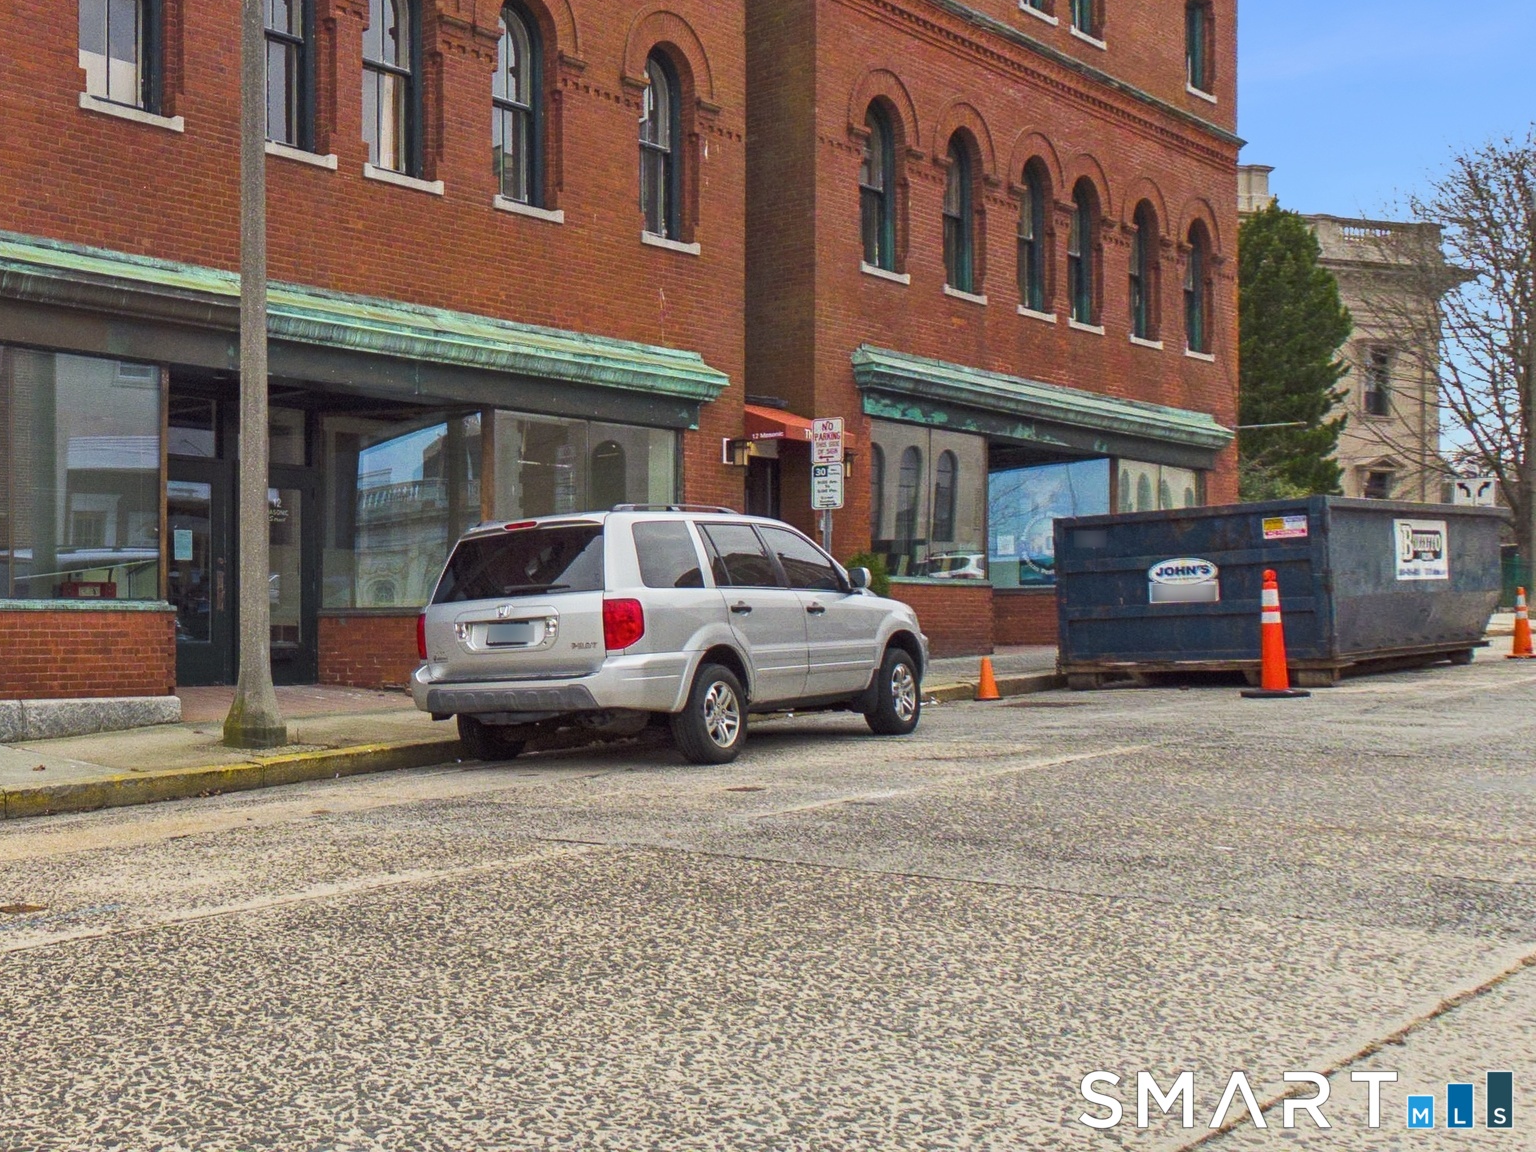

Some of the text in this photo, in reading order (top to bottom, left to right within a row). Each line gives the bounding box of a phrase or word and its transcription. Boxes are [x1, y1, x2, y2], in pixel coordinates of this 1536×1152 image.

[822, 422, 833, 430] NO
[814, 432, 840, 441] PARKING
[815, 467, 826, 476] 30
[1155, 564, 1211, 577] JOHN'S
